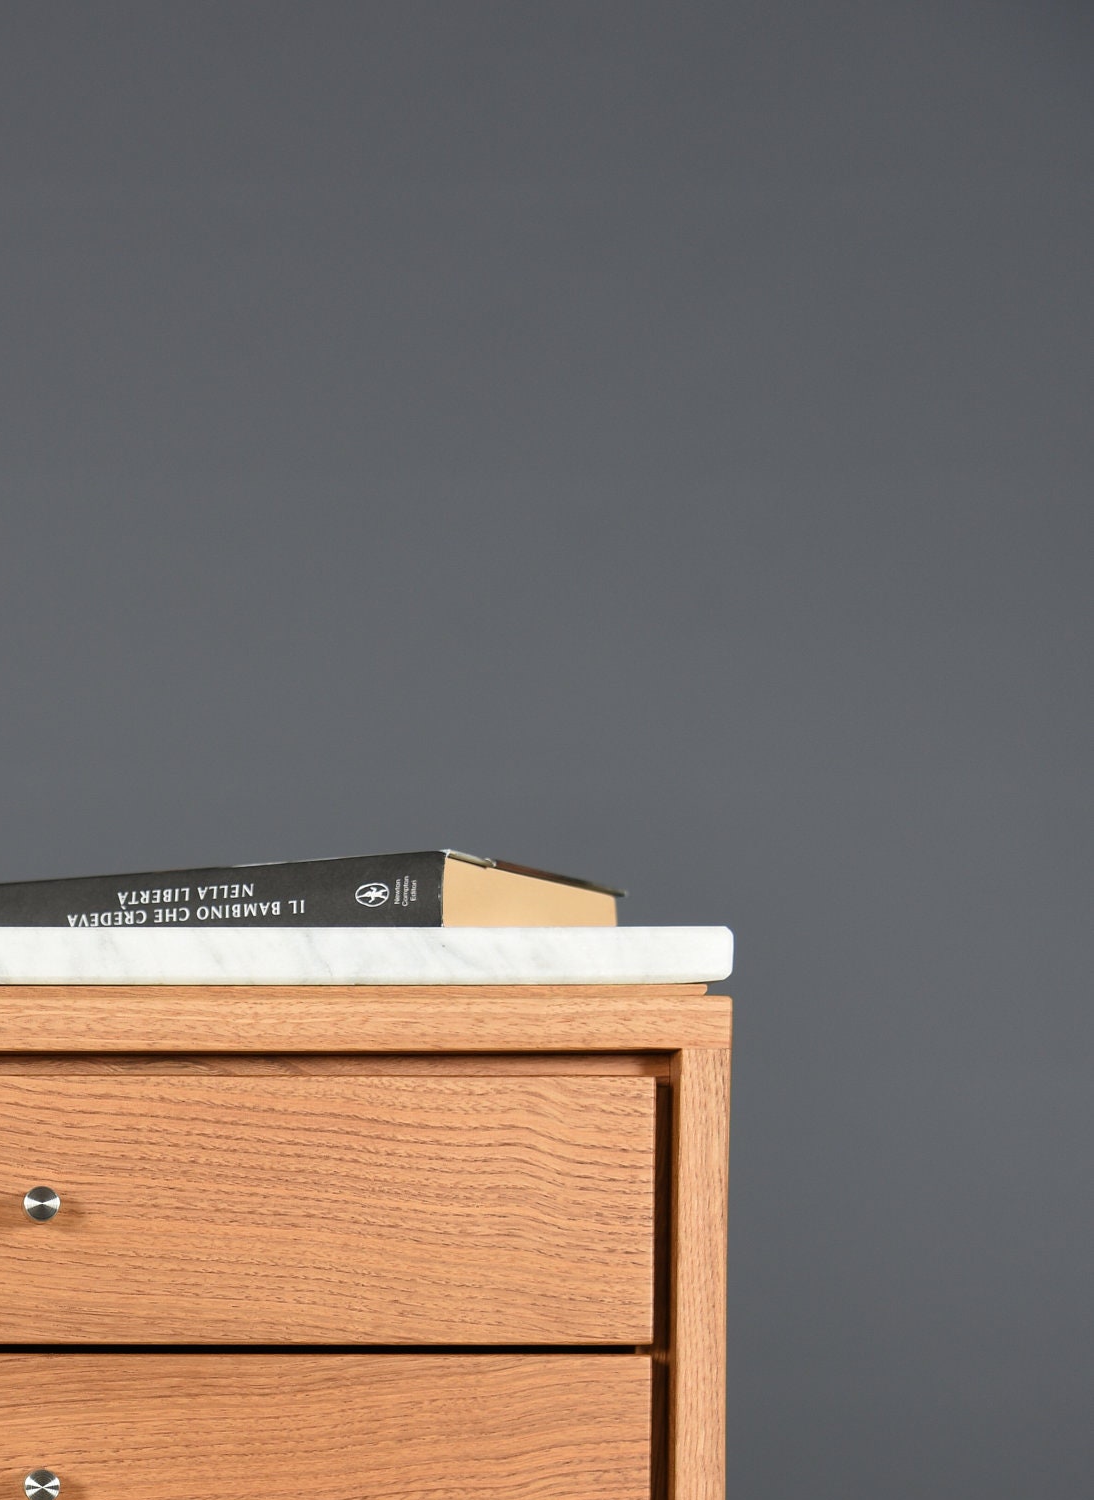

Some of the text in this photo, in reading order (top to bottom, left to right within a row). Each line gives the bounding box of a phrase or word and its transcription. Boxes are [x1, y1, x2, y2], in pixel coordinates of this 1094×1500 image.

[117, 883, 254, 910] NELLA LIBERTÀ
[401, 875, 409, 907] Compton
[67, 900, 305, 927] IL BAMBINO CHE CREDEVA
